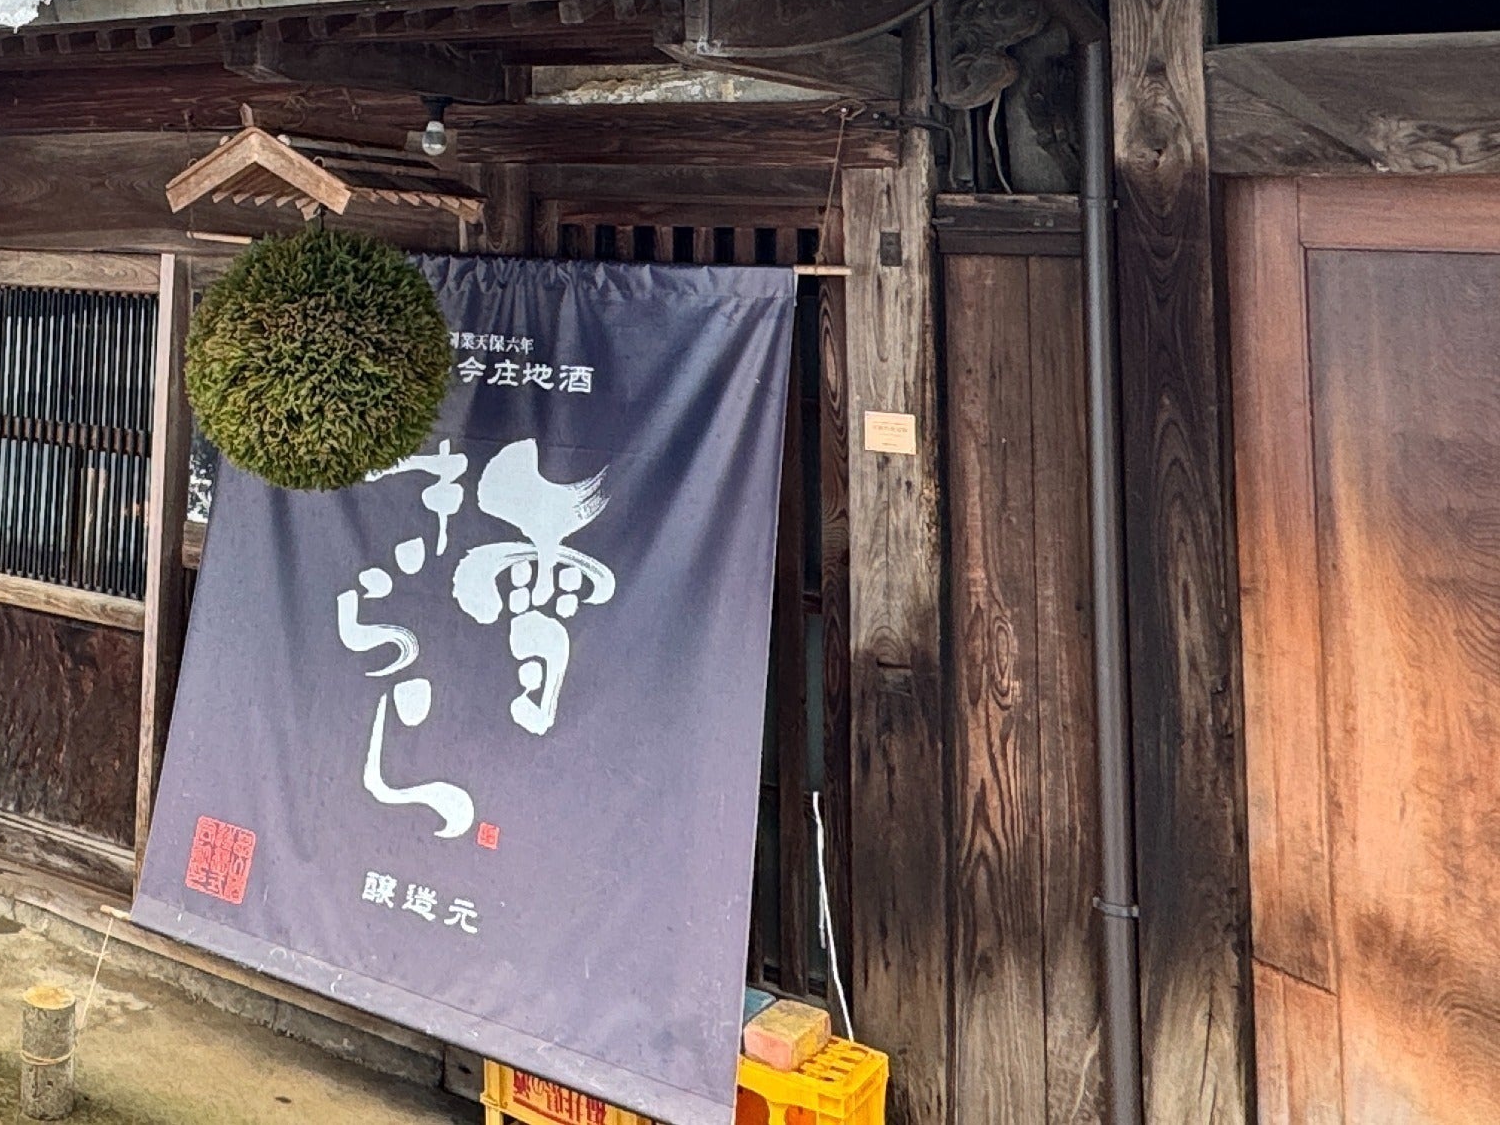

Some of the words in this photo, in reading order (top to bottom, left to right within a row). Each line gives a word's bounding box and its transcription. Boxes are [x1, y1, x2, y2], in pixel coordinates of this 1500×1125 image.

[448, 356, 595, 394] 今庄地酒
[361, 871, 478, 934] 醸造元
